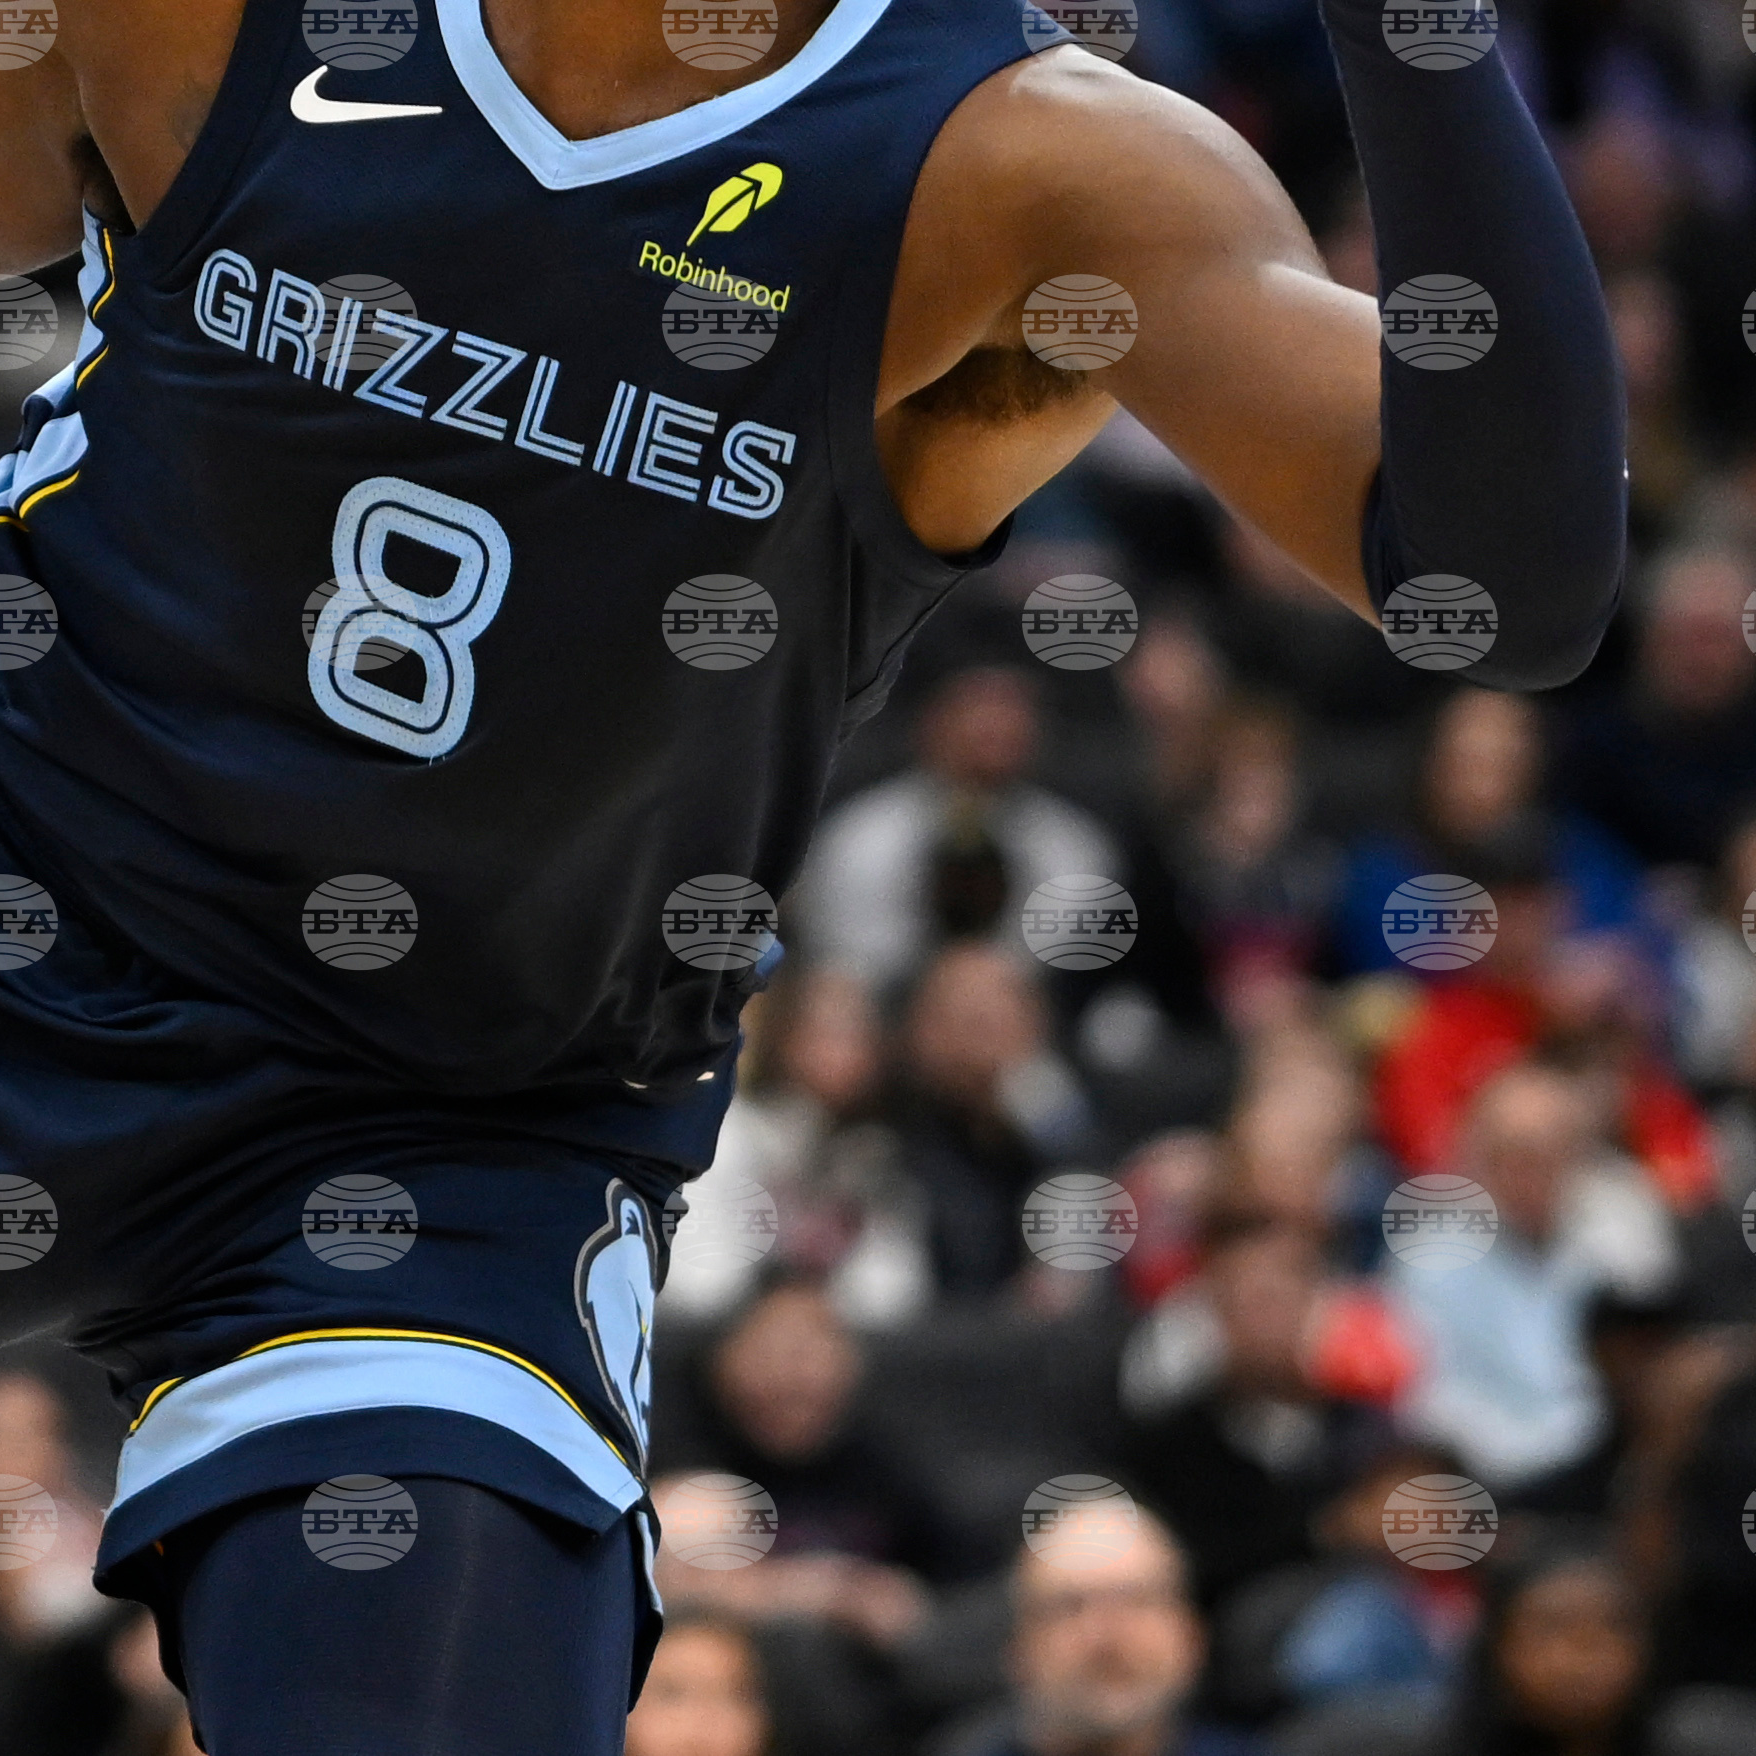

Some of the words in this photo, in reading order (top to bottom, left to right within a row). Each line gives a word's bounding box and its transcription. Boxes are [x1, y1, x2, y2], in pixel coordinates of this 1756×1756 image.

[193, 248, 798, 521] GRIZZLIES
[638, 239, 791, 314] Robinhood
[306, 475, 511, 761] 8
